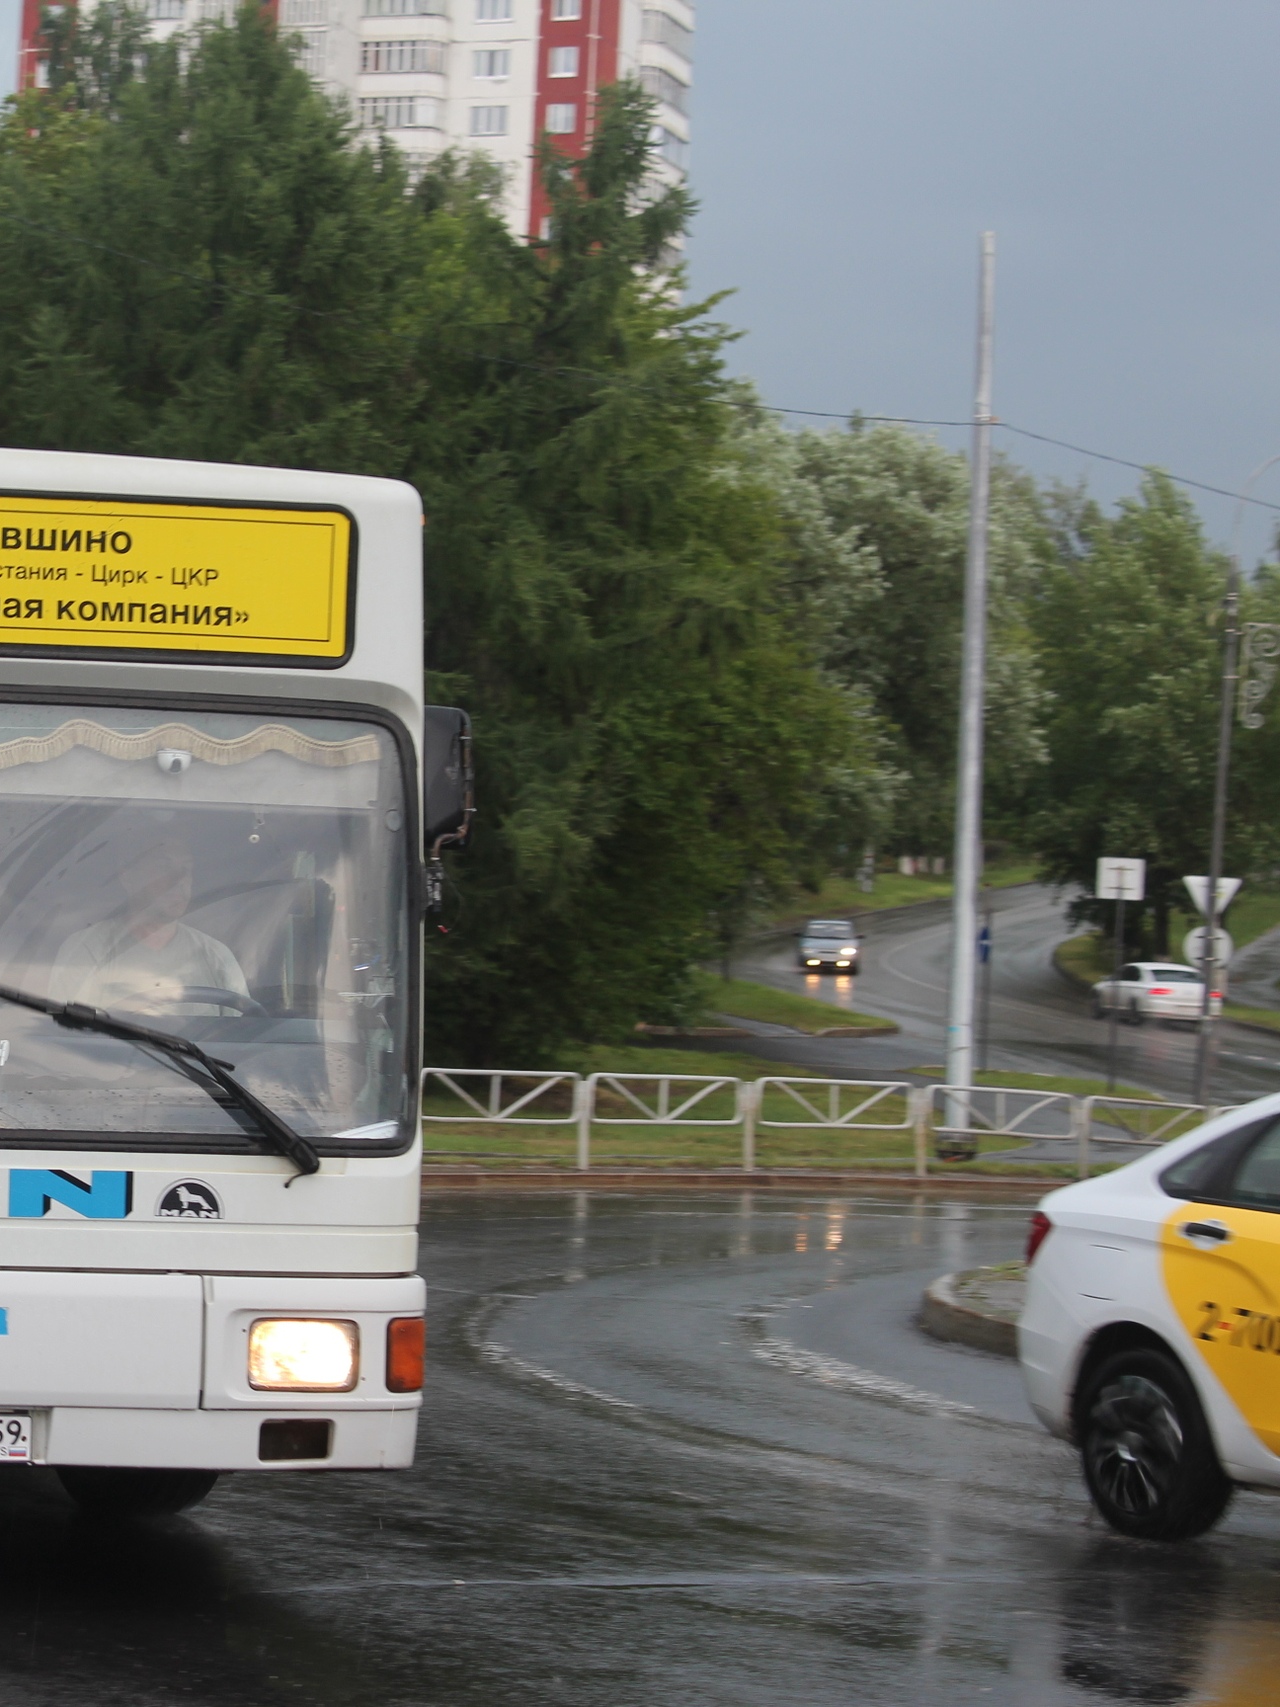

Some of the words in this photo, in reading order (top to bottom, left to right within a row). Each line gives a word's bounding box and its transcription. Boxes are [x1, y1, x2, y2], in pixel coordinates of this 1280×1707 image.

[91, 565, 148, 588] Цирк
[171, 567, 219, 589] ЦКР
[57, 599, 250, 628] компания»
[161, 1209, 219, 1219] MAN
